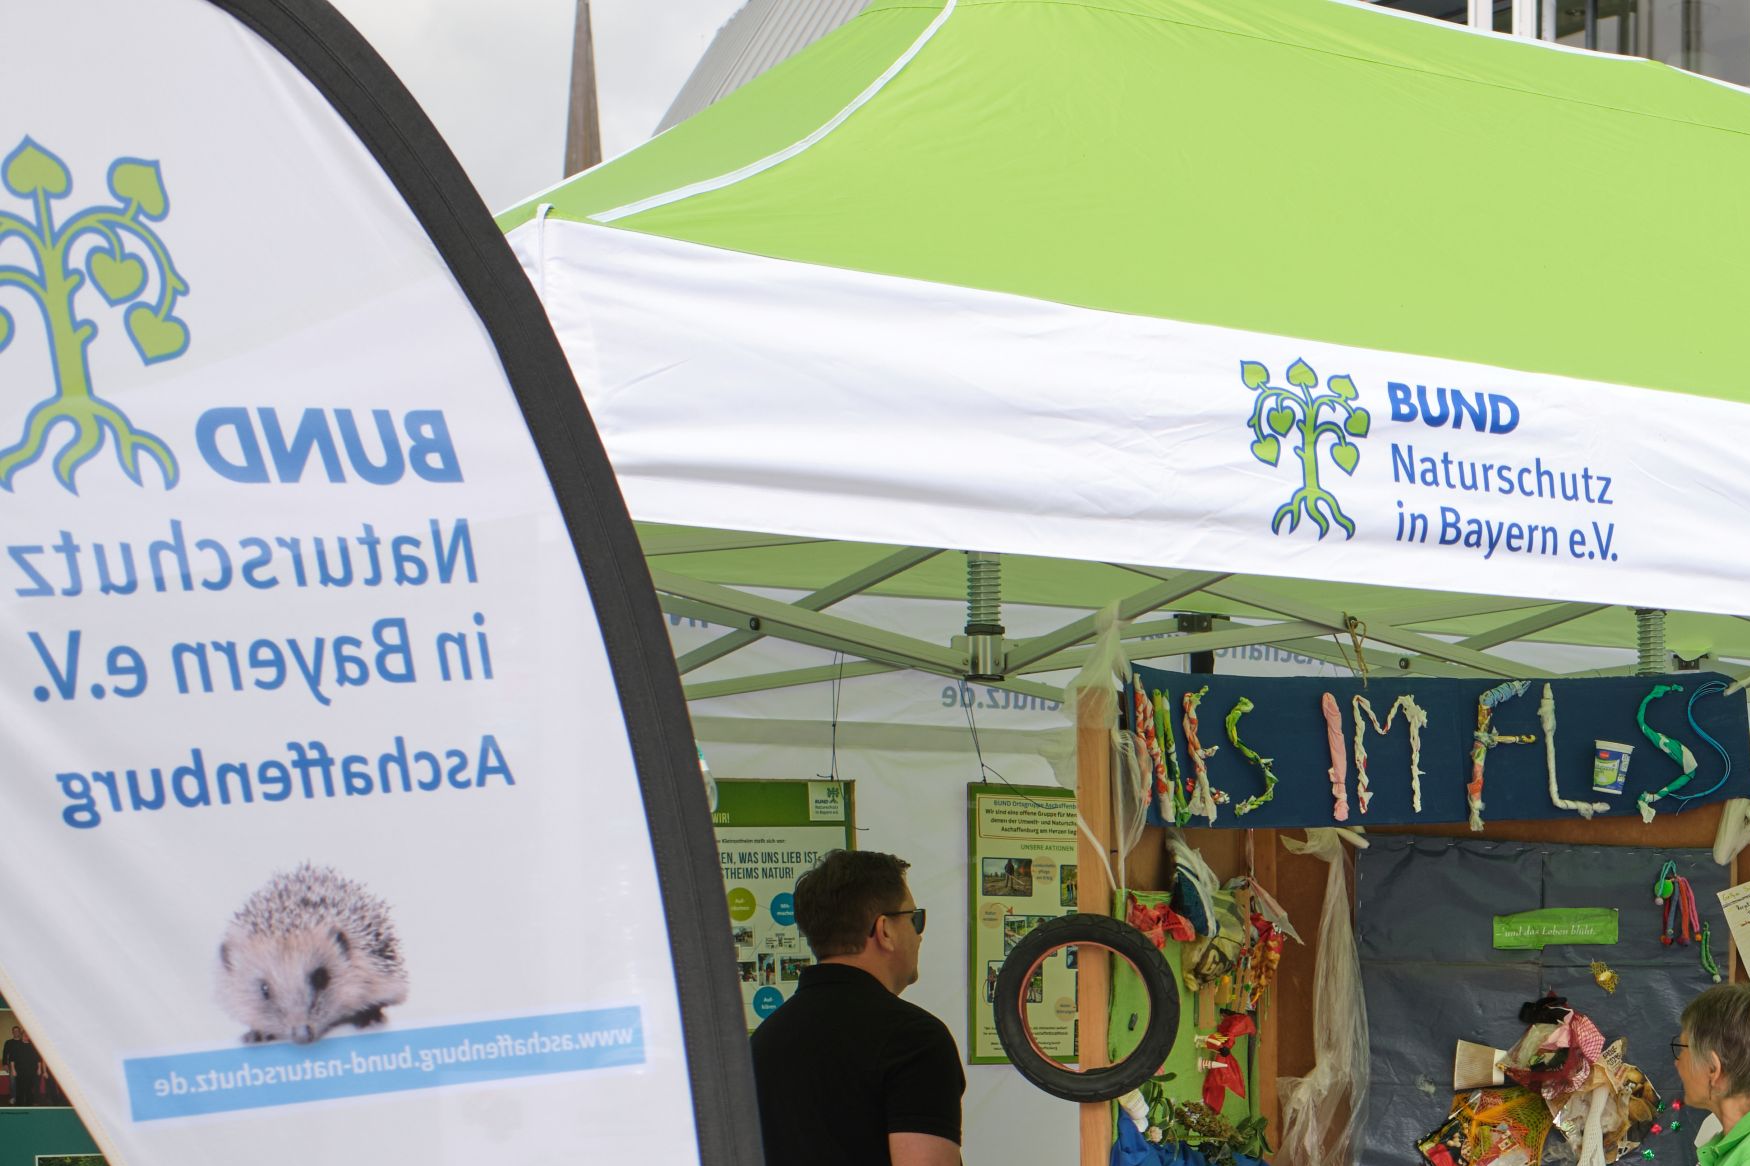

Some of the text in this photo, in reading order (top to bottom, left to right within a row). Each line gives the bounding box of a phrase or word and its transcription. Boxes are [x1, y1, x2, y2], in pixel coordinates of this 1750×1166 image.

[1387, 381, 1520, 435] BUND
[1391, 443, 1613, 504] Naturschutz
[1395, 501, 1618, 562] in Bayern e.V.
[1323, 692, 1427, 822] IM
[739, 852, 759, 864] WAS
[762, 852, 778, 864] UNS
[781, 851, 801, 863] LIEB
[761, 867, 794, 879] NATUR!
